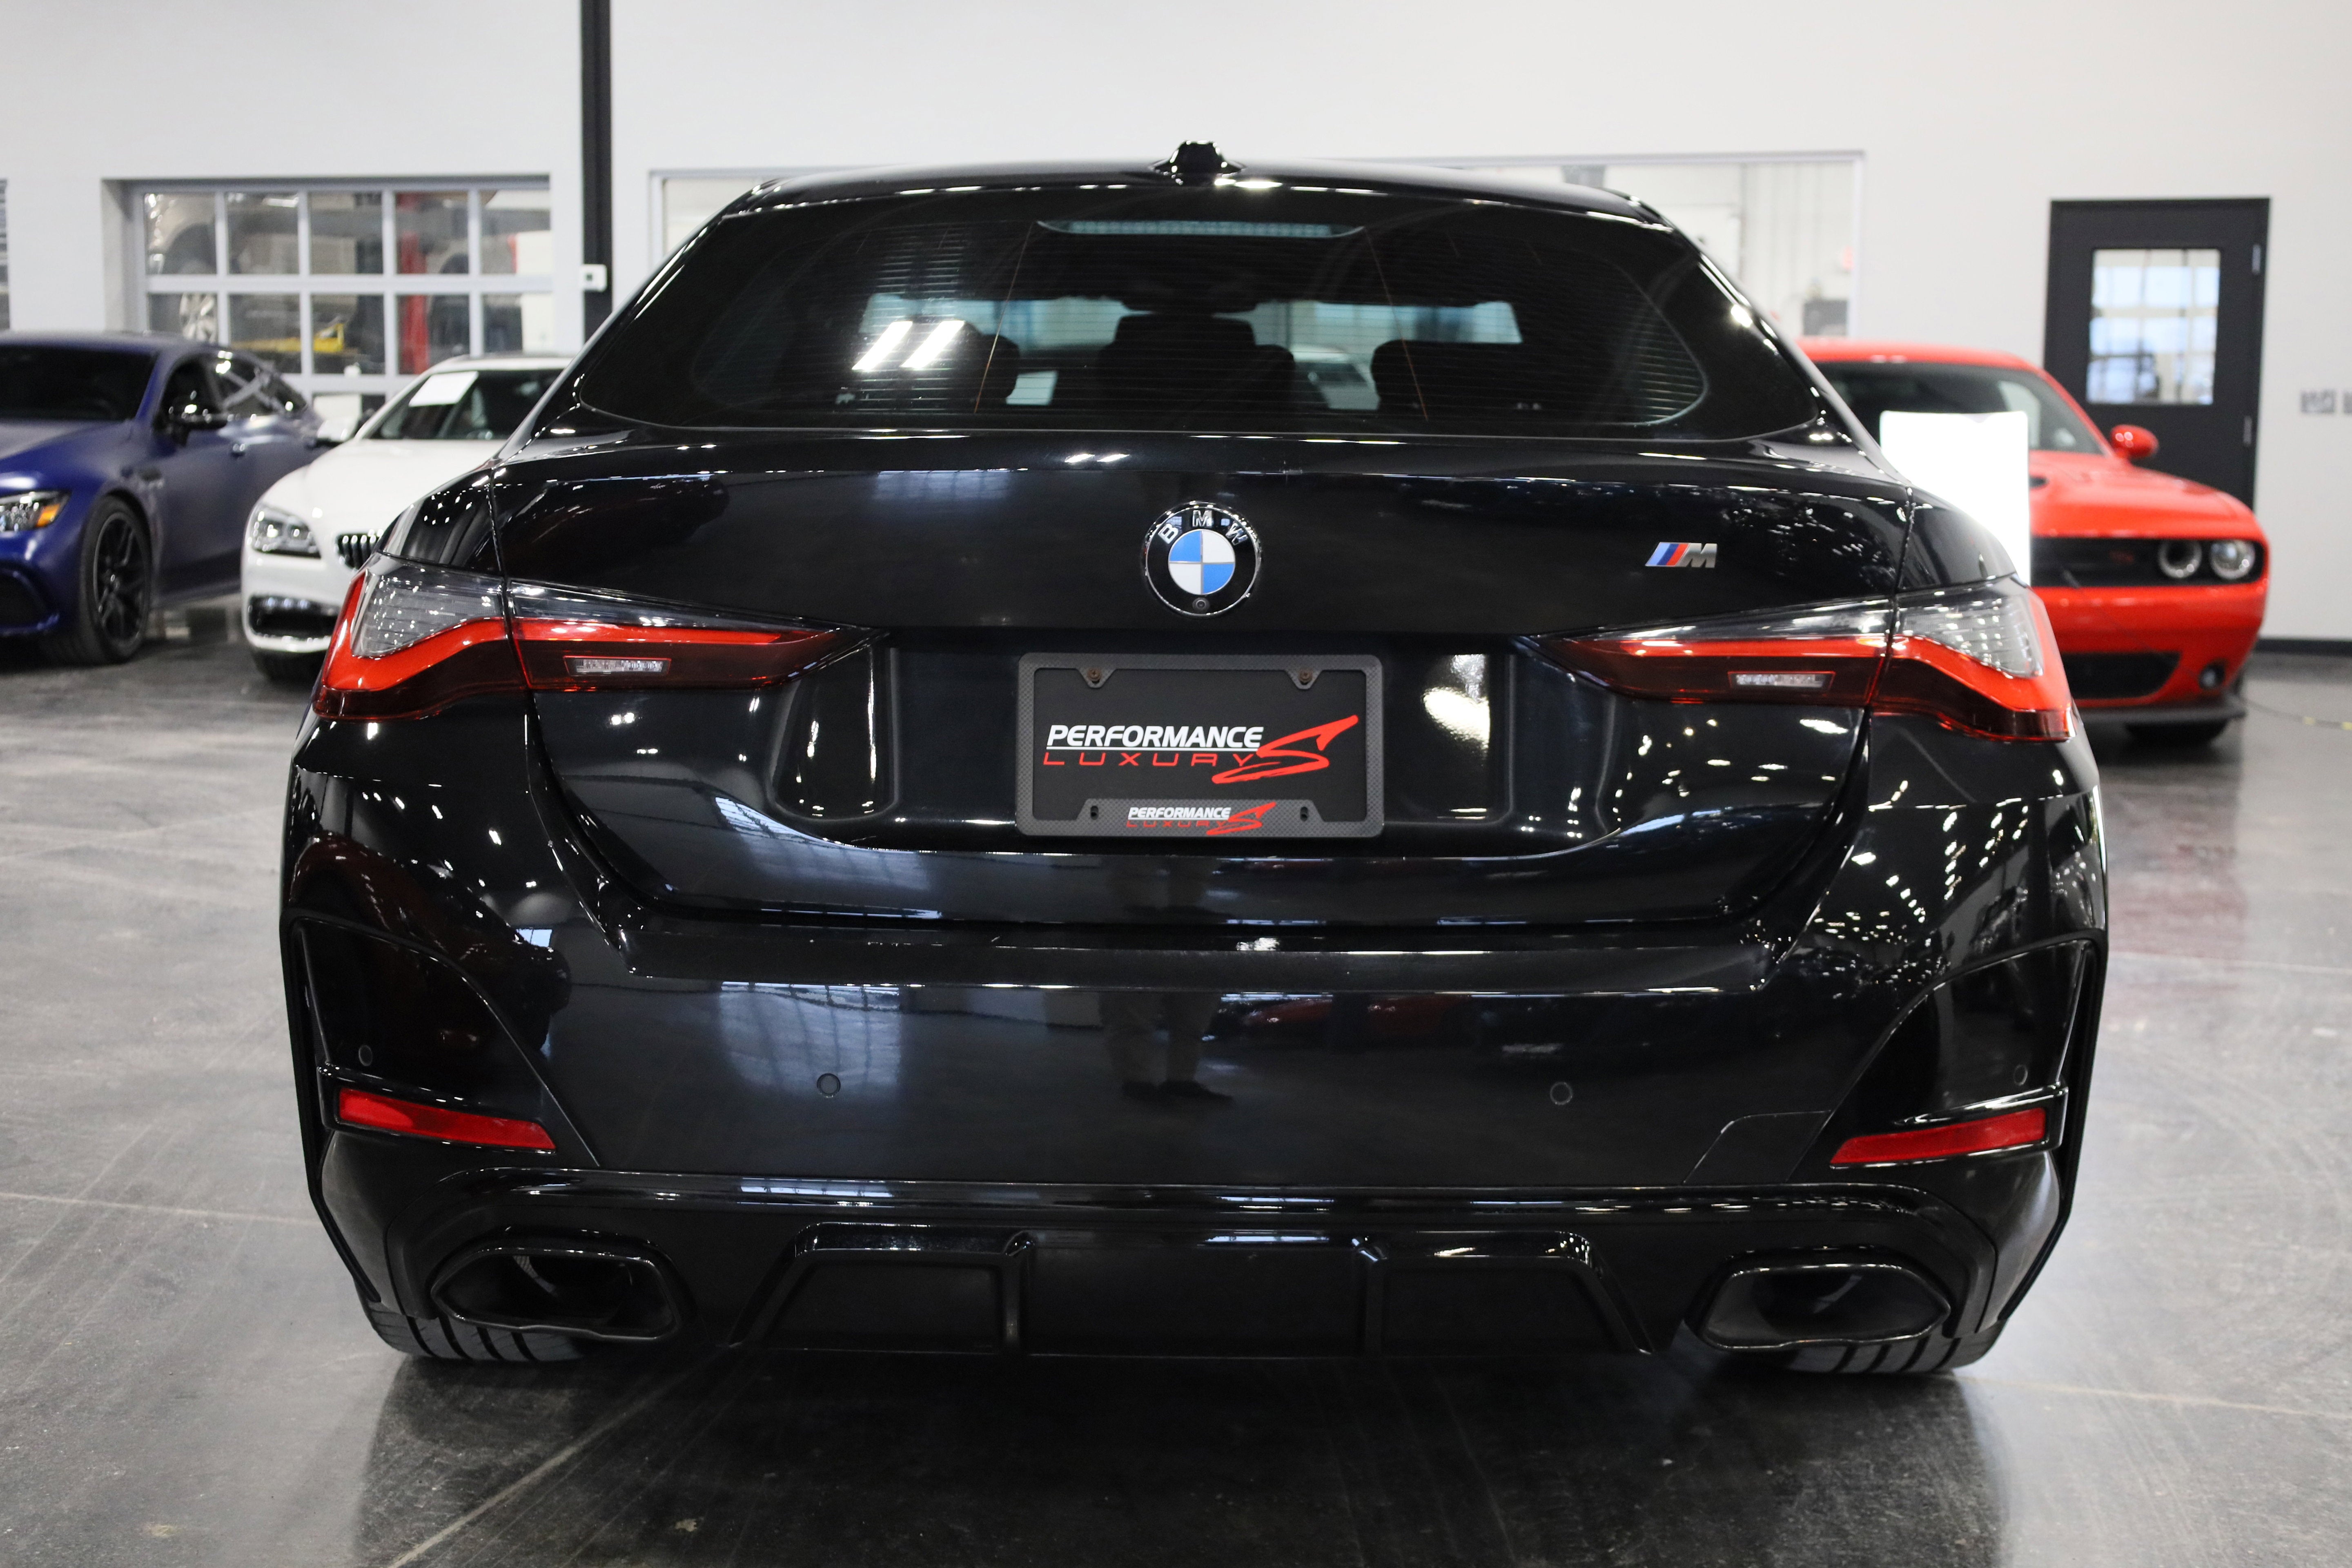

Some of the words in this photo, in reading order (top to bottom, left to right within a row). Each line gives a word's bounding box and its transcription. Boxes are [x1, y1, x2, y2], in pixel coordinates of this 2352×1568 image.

[1157, 510, 1248, 546] BMW
[1674, 542, 1717, 568] M
[1047, 725, 1263, 748] PERFORMANCE
[1043, 752, 1253, 767] LUXURY
[1128, 807, 1232, 818] PERFORMANCE
